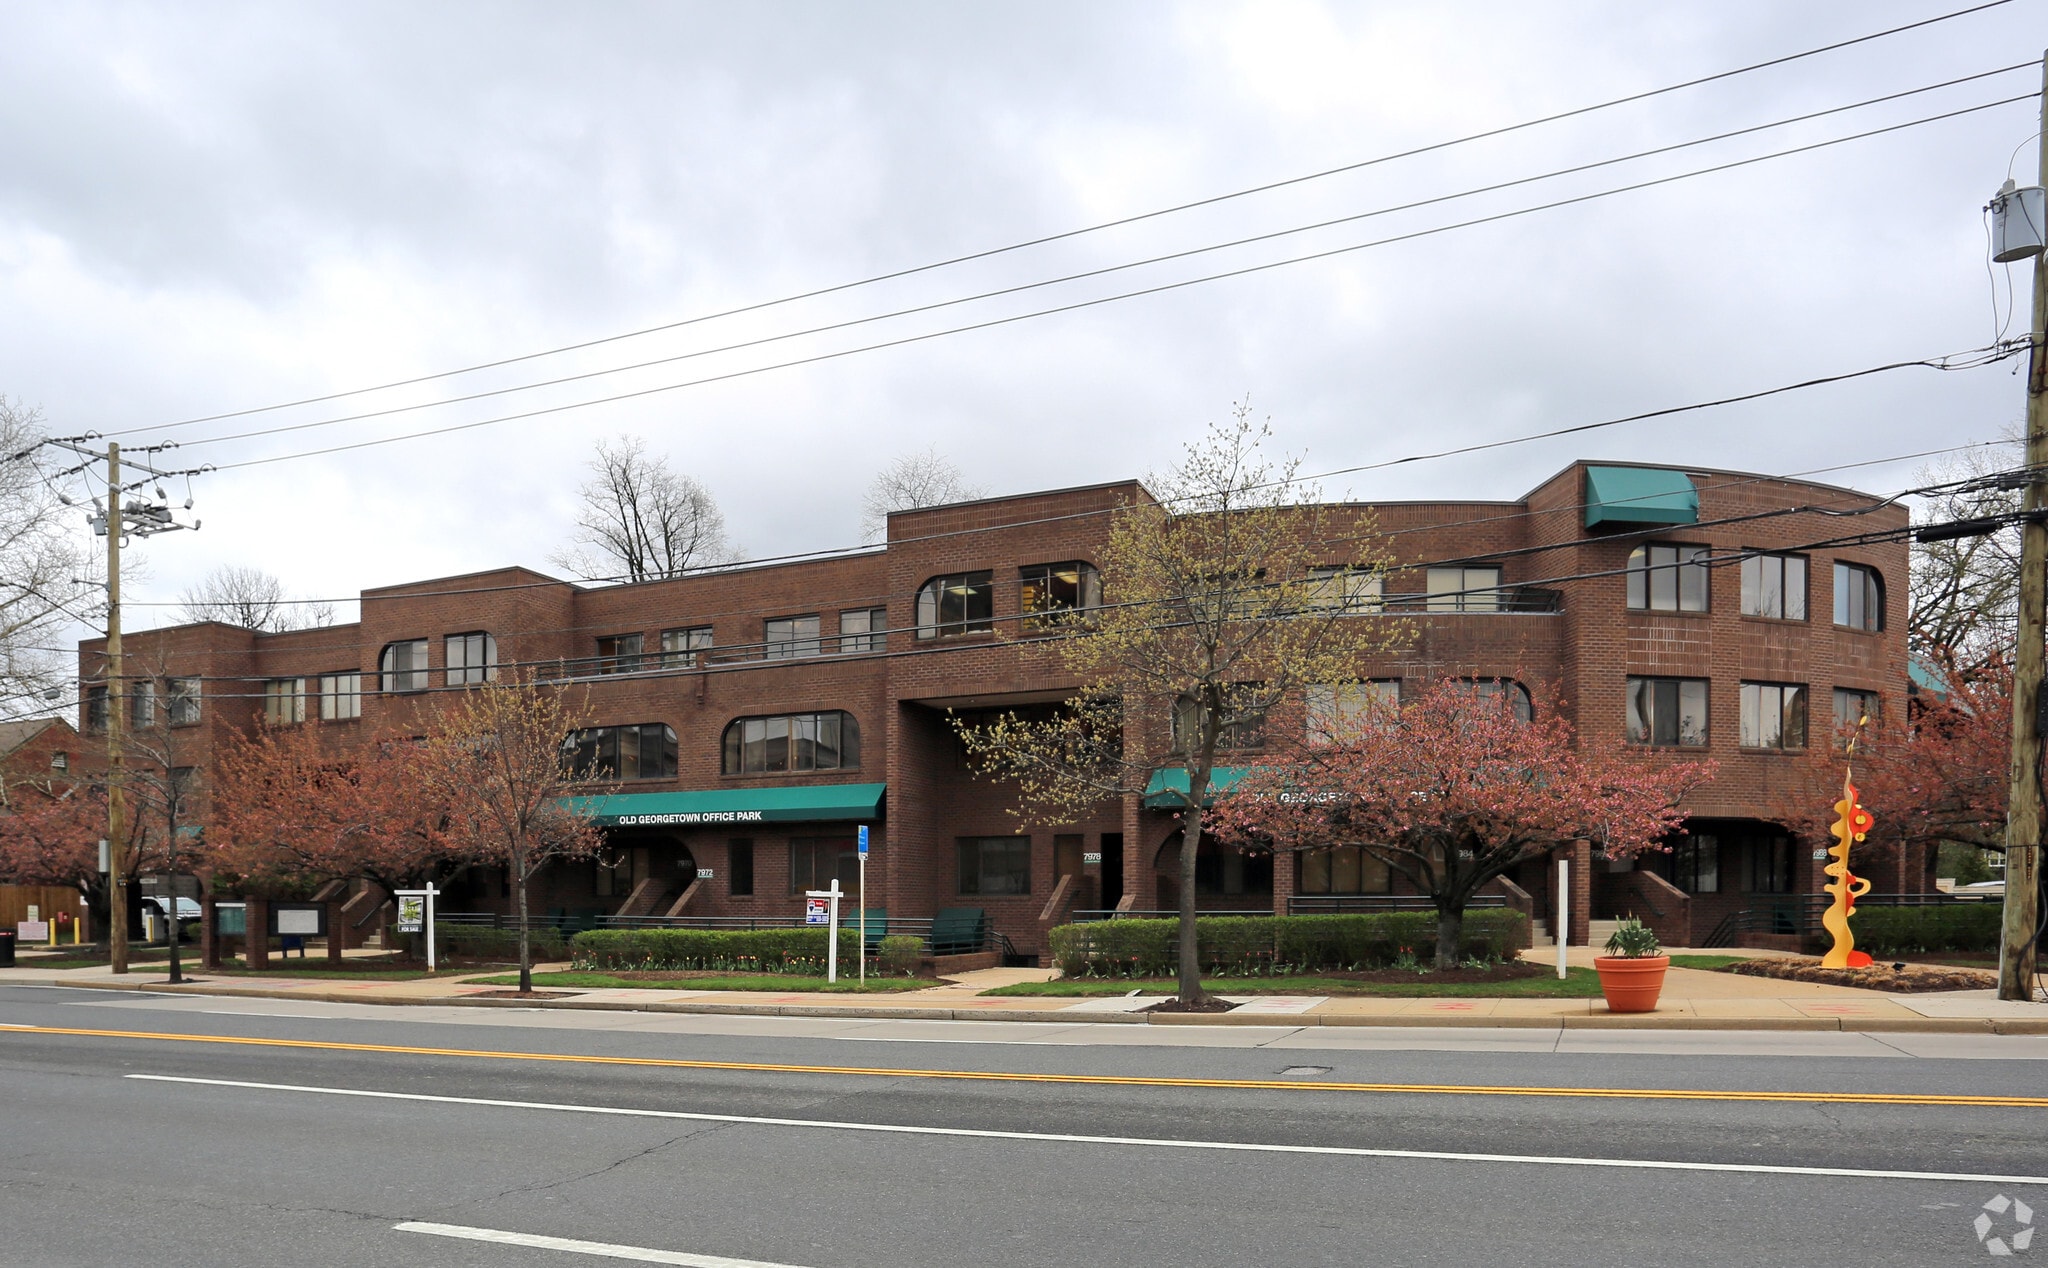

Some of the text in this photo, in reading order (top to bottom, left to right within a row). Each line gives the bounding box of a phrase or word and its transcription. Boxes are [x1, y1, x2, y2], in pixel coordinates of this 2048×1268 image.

[619, 811, 762, 825] OLD GEORGETOWN OFFICE PARK
[1083, 852, 1101, 861] 7978
[696, 868, 713, 876] 7972
